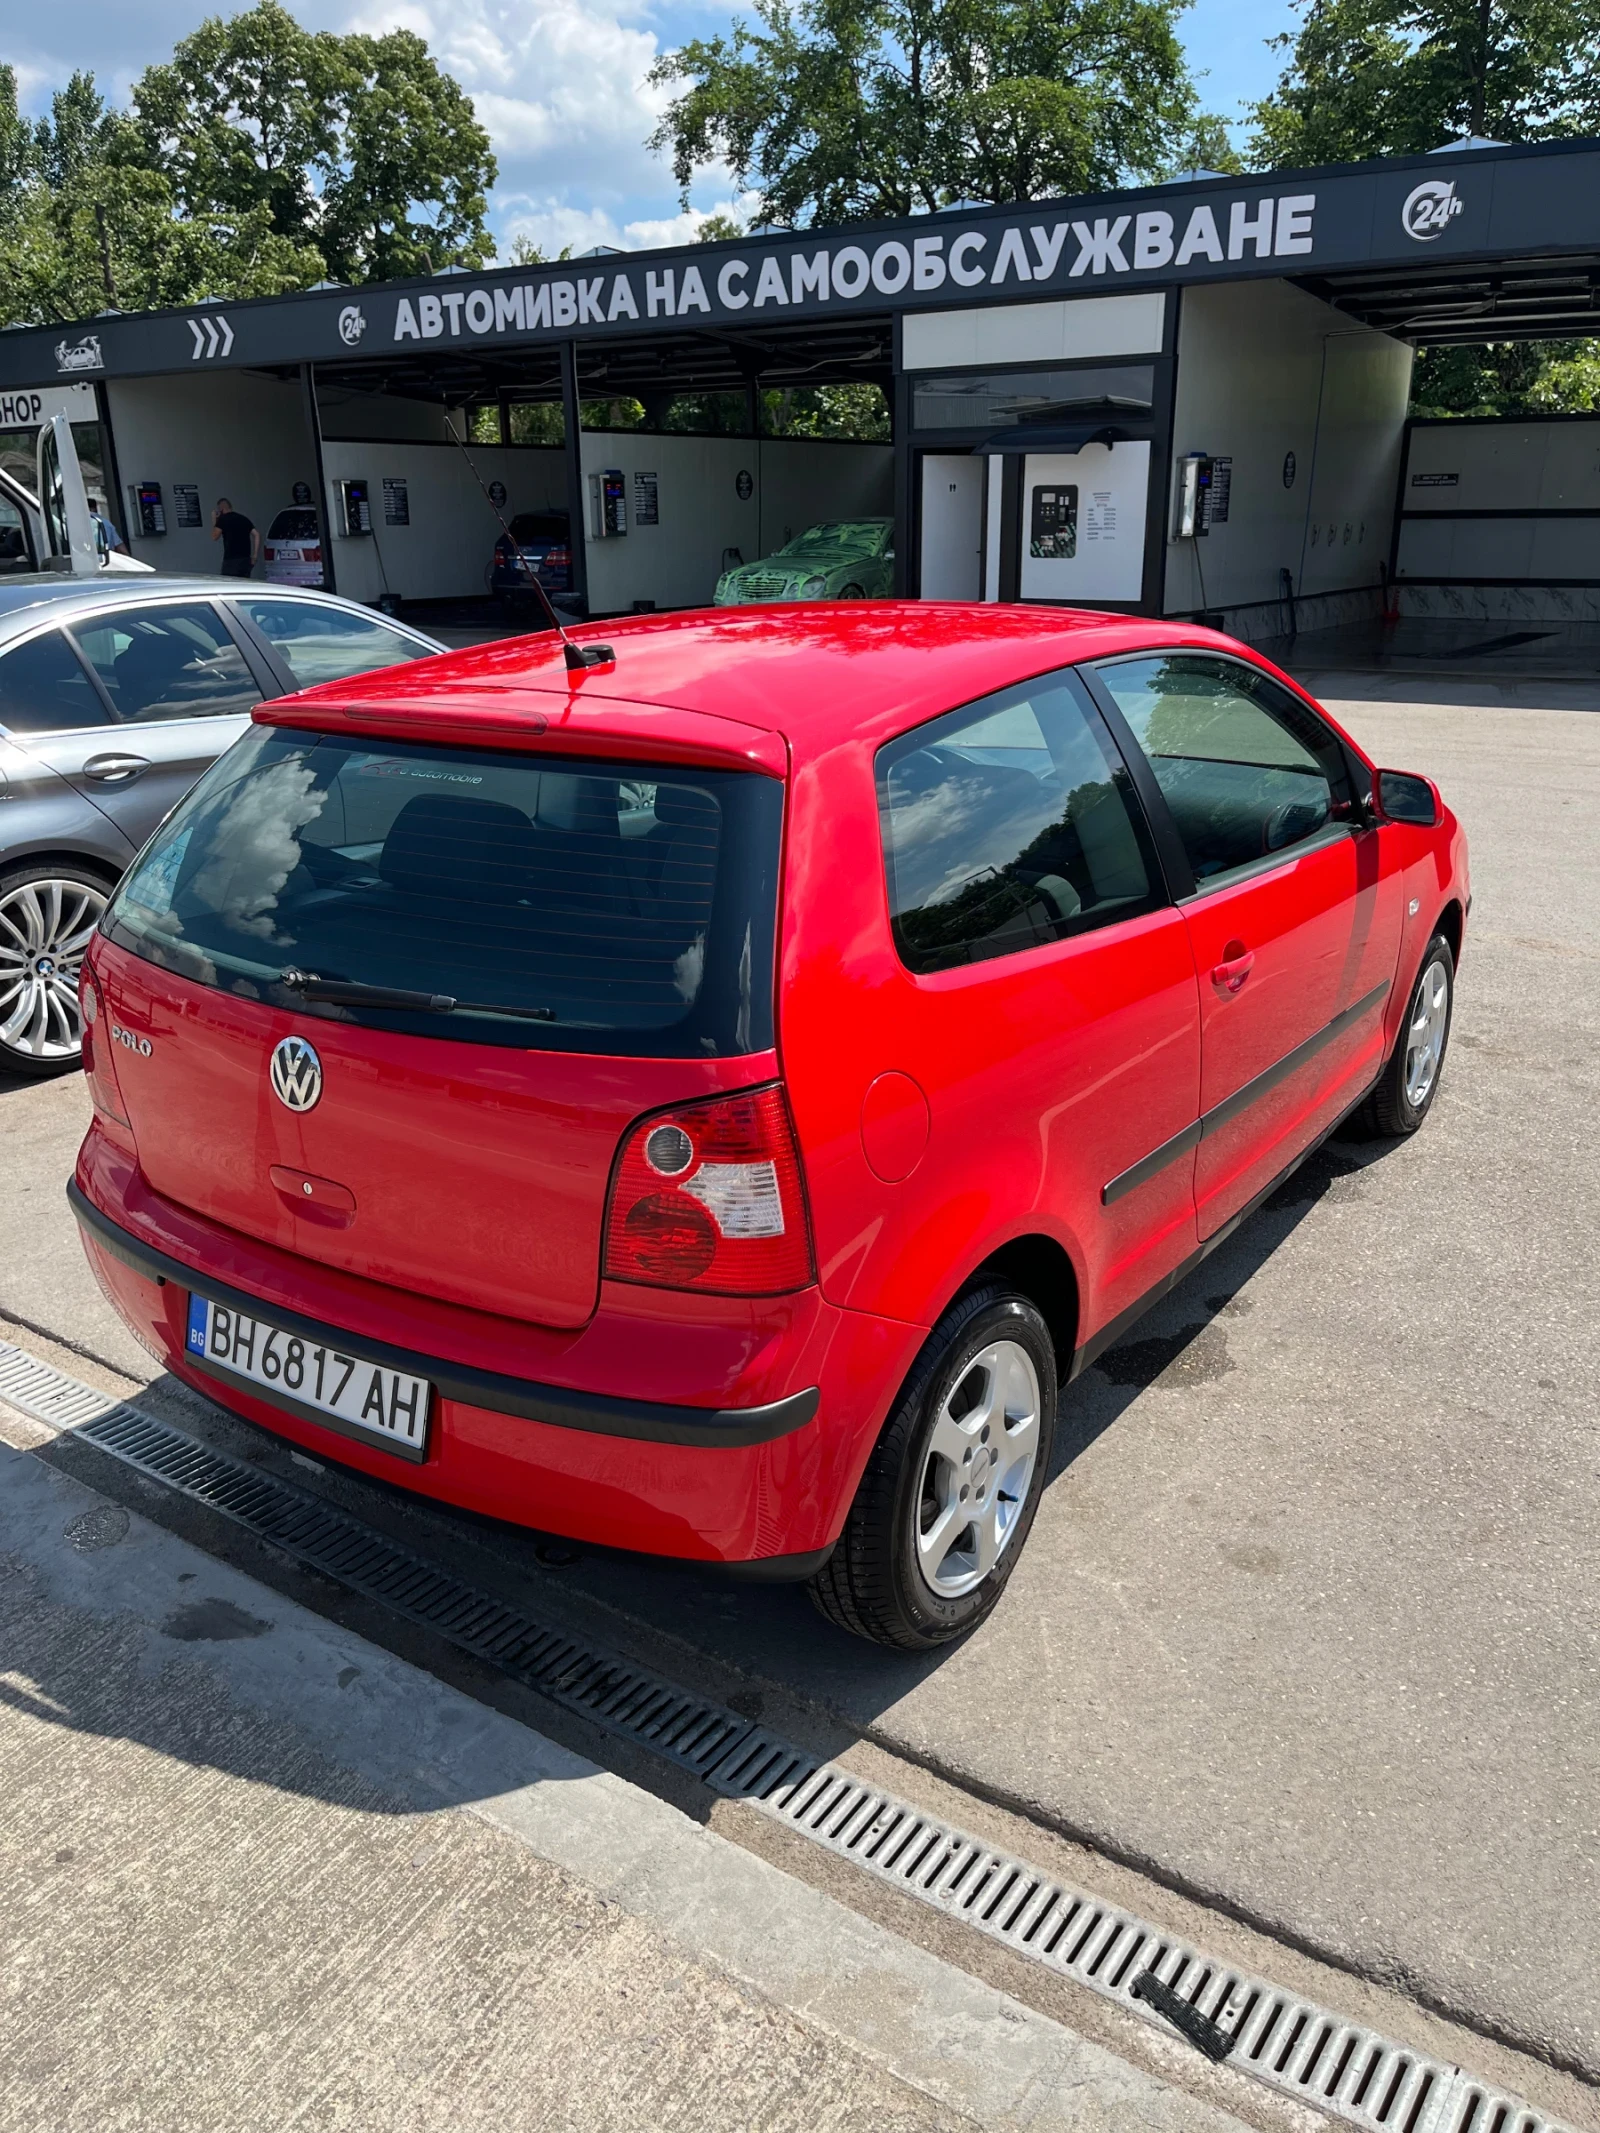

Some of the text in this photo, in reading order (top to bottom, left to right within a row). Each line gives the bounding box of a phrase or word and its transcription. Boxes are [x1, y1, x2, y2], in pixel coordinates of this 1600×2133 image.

[393, 193, 1316, 342] АВТОМИВКА НА САМООБСЛУЖВАНЕ
[411, 768, 483, 784] automobile
[111, 1024, 153, 1058] POLO
[190, 1328, 204, 1347] BG
